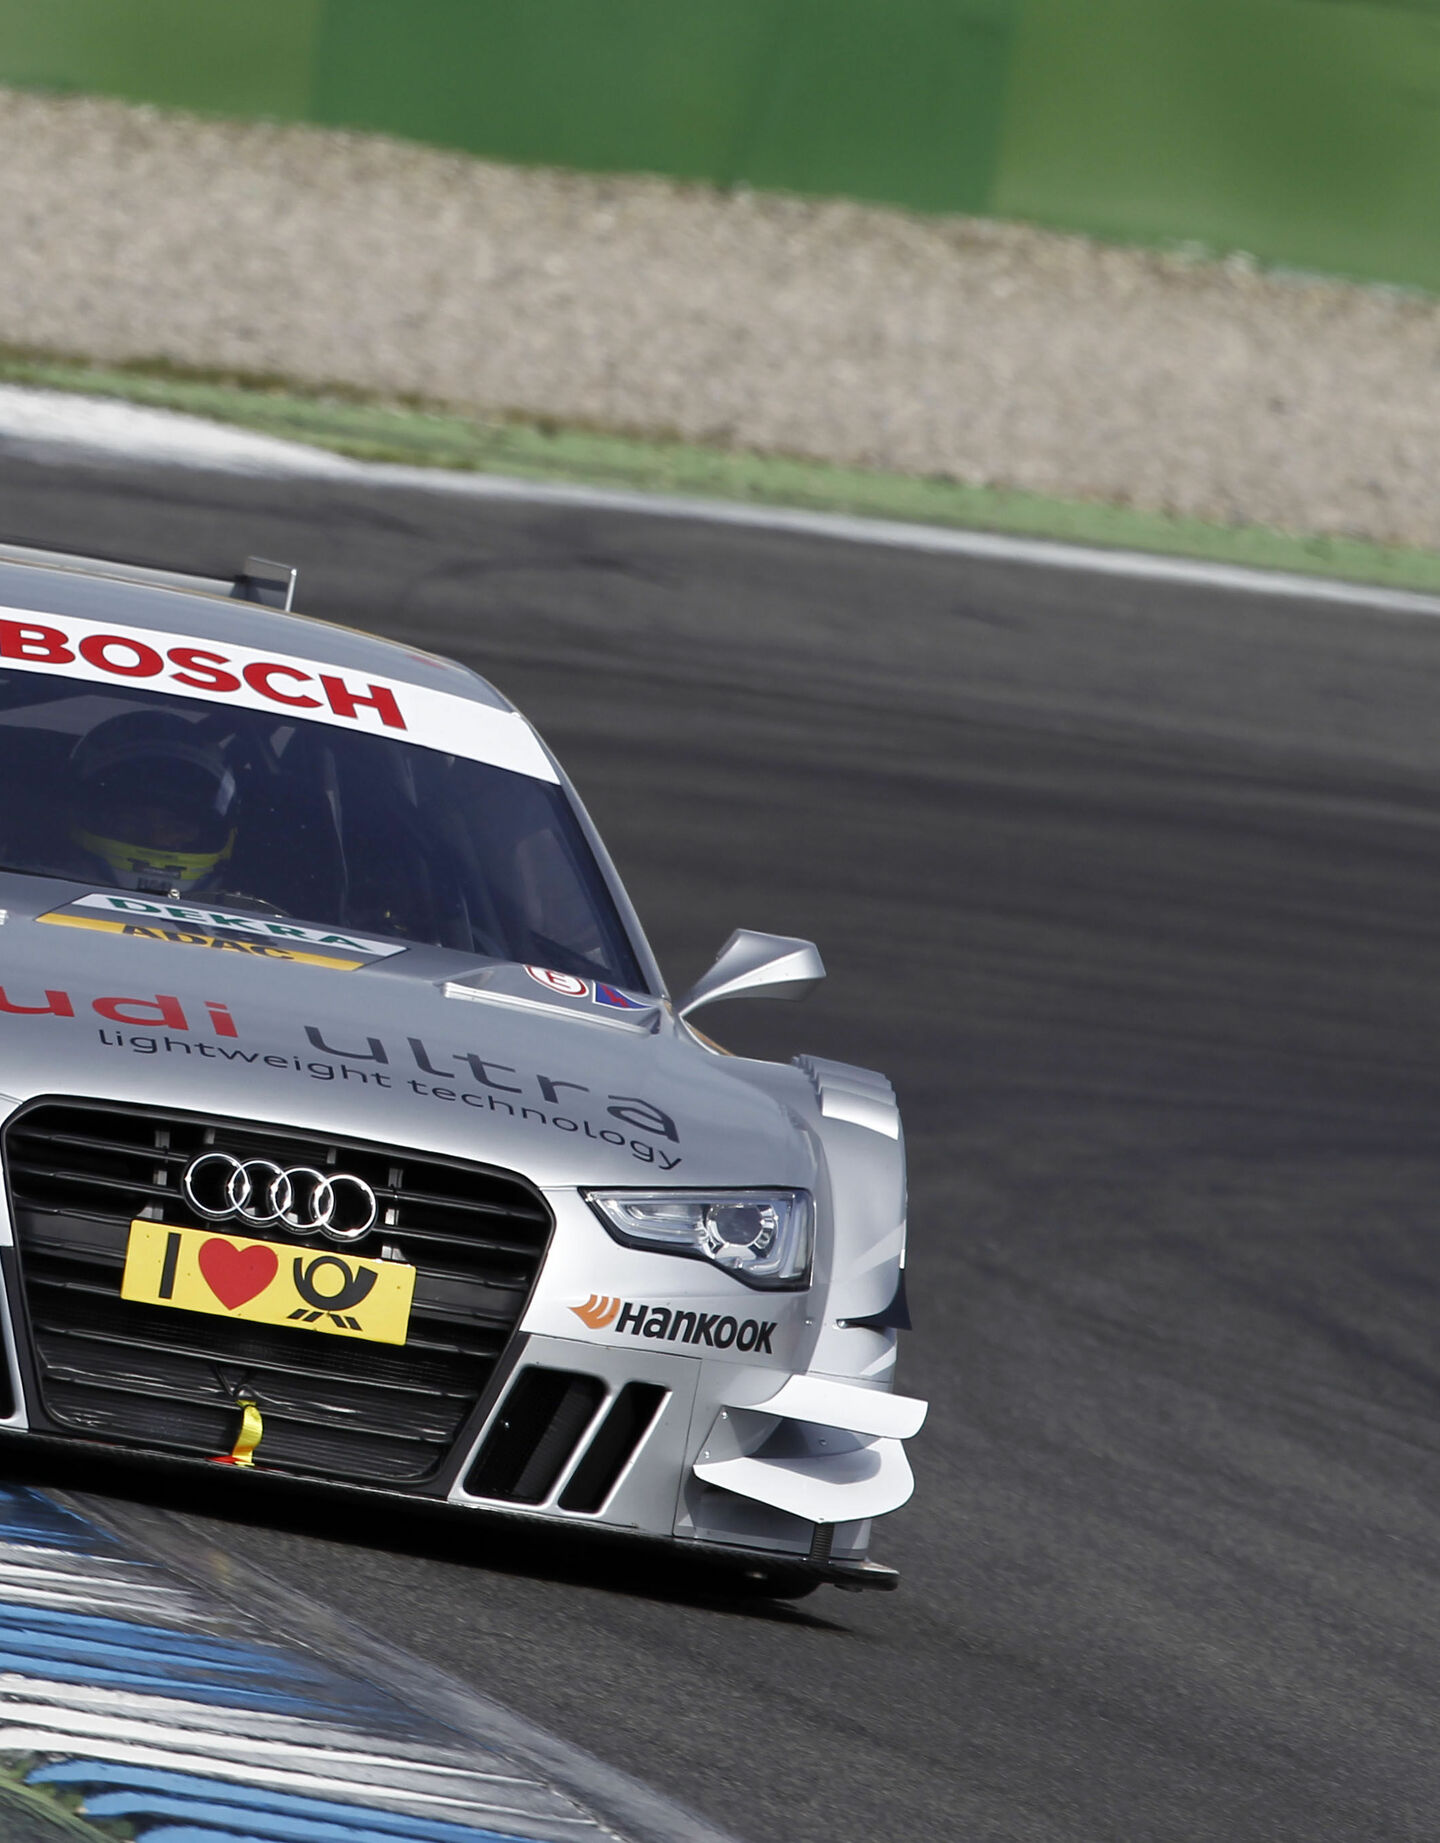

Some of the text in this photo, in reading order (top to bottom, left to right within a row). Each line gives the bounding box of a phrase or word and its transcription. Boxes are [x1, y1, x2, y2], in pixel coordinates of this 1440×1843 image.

[106, 897, 373, 950] DEKRA
[121, 924, 295, 960] ADAC
[98, 1029, 682, 1171] lightweight technology
[303, 1025, 680, 1144] ultra
